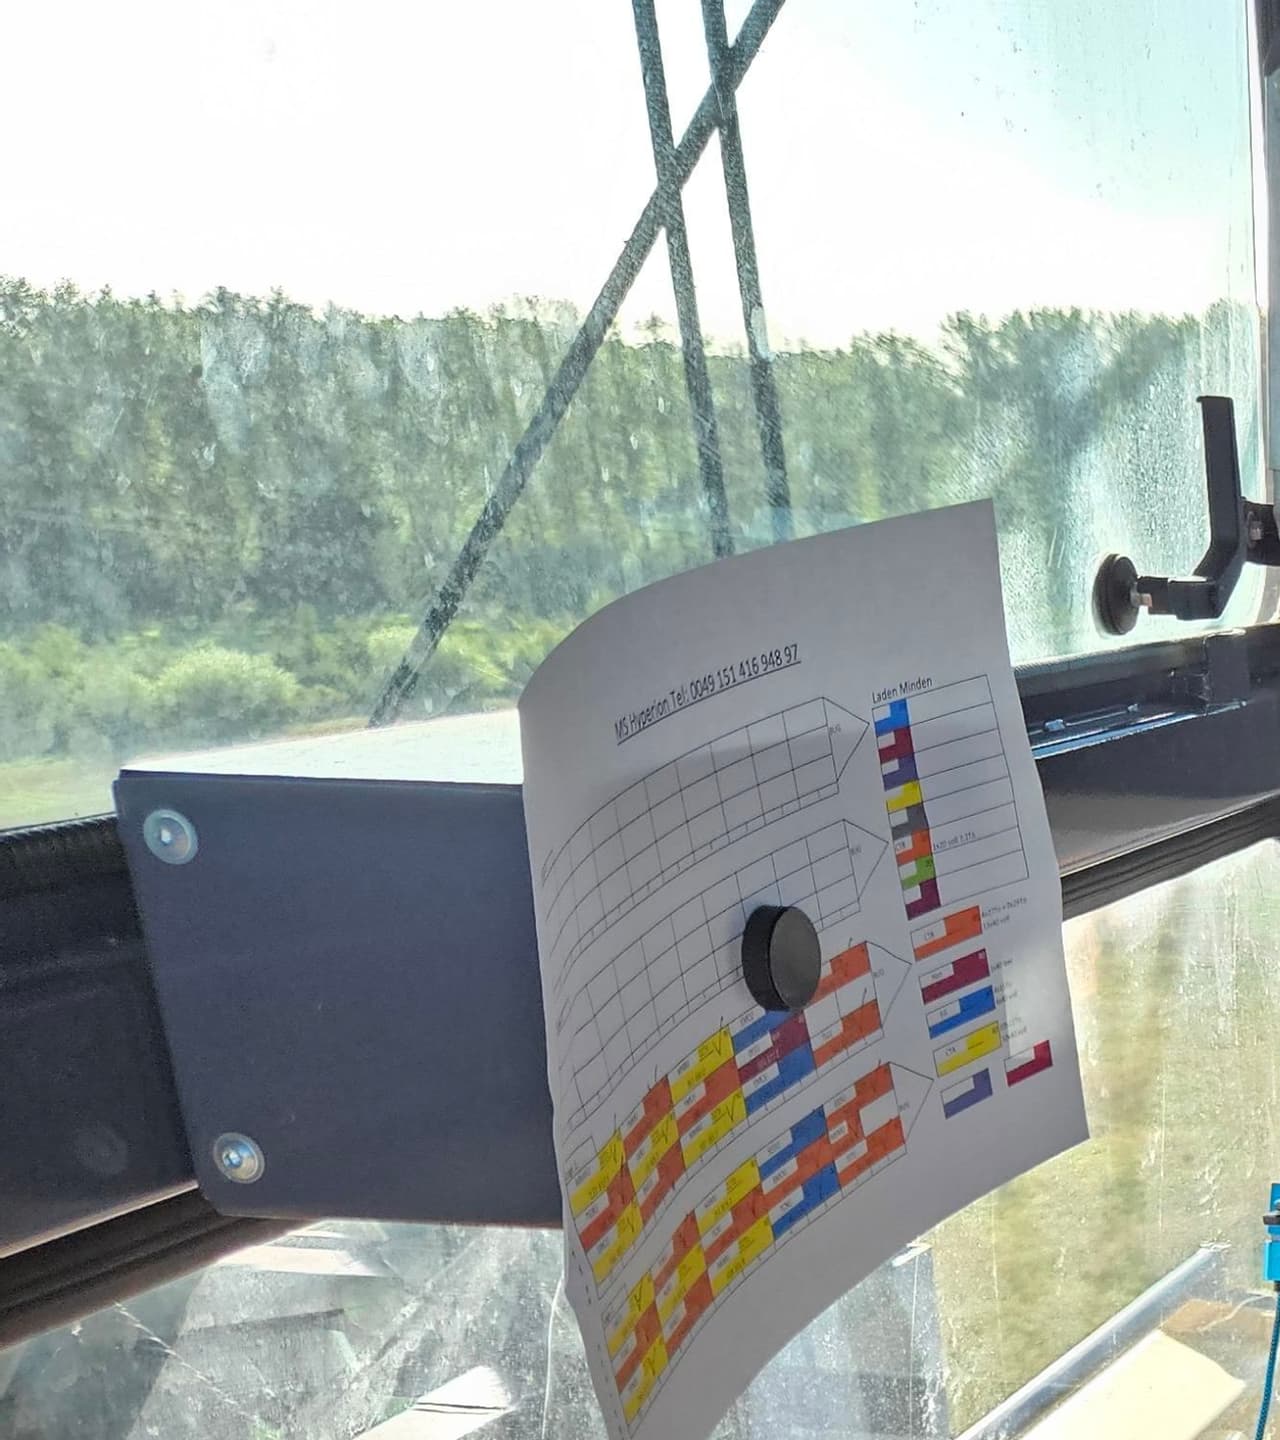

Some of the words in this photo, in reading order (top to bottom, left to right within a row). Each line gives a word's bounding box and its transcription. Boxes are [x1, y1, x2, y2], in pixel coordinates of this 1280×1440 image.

[629, 698, 670, 734] Hyperion
[690, 673, 716, 701] 0049
[716, 665, 737, 690] 151
[738, 657, 760, 680] 416
[760, 649, 783, 672] 948
[784, 643, 800, 664] 97
[872, 686, 898, 704] Laden
[899, 676, 933, 695] Minden
